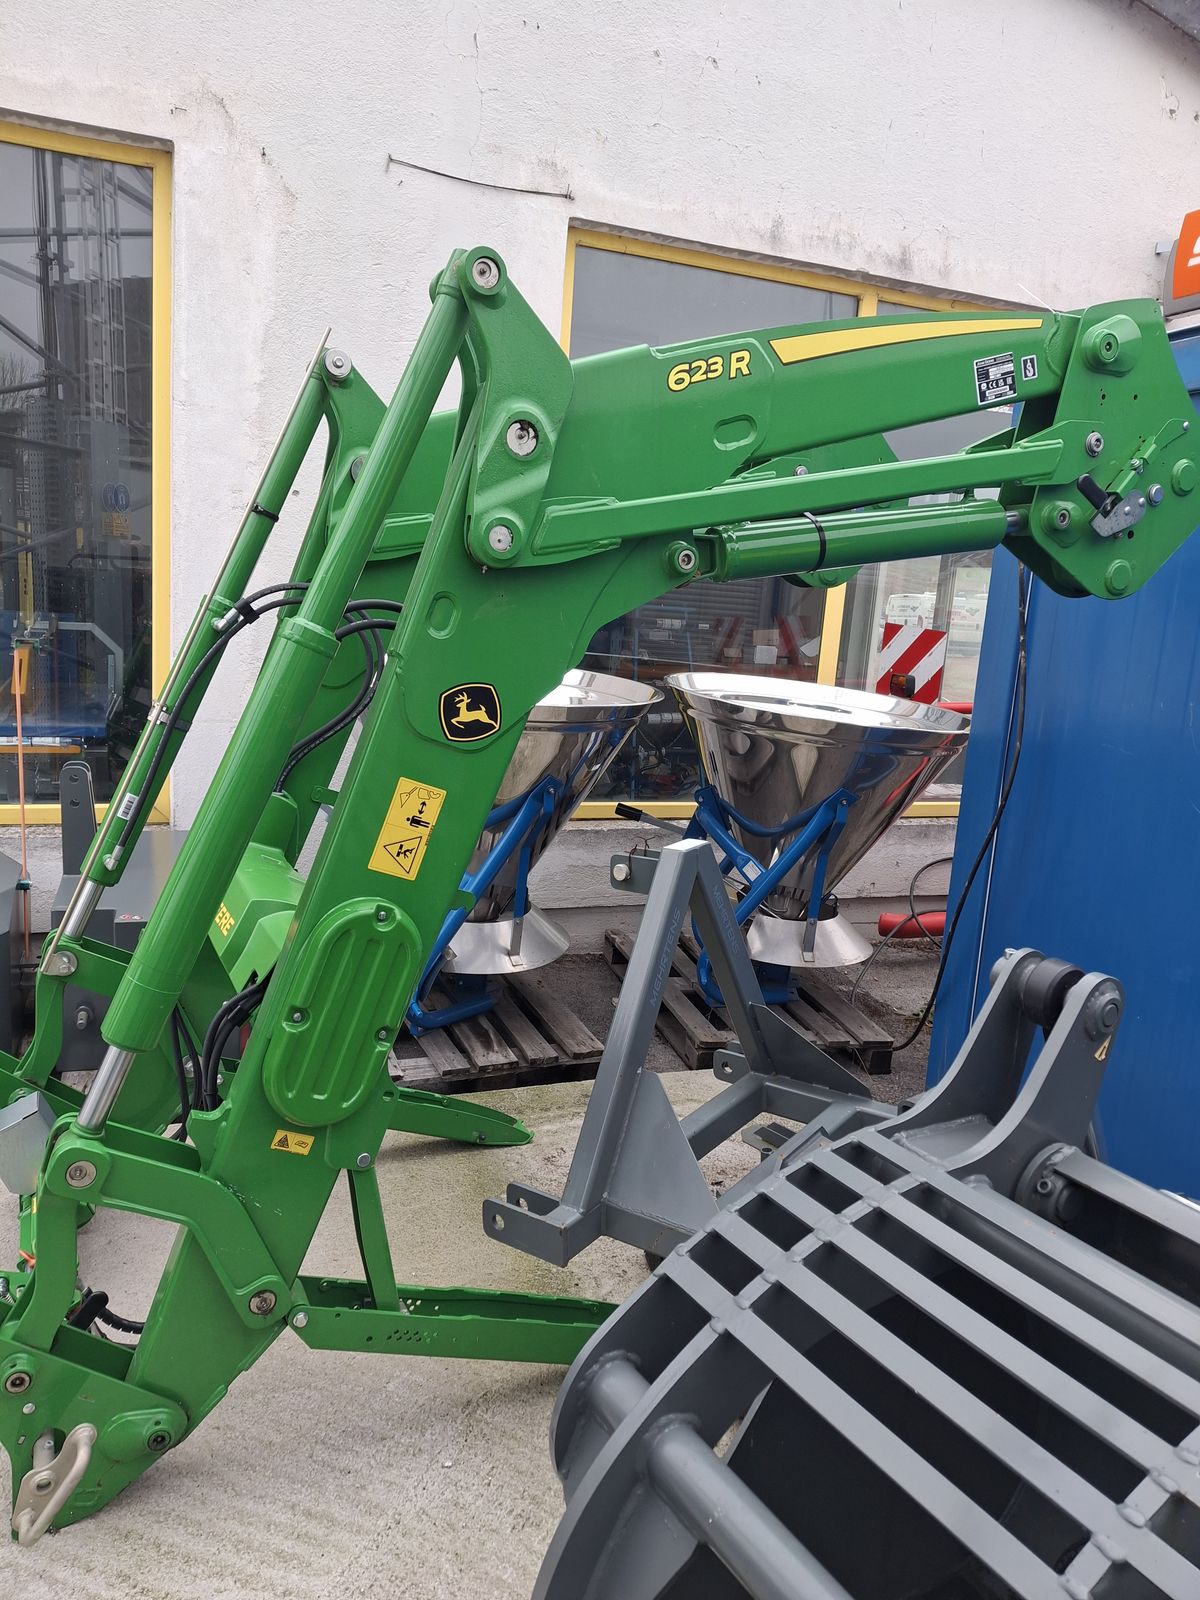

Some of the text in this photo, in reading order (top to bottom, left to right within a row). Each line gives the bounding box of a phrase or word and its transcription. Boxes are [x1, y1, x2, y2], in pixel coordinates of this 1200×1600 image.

[667, 349, 751, 392] 623 R
[214, 901, 236, 937] ERE
[650, 908, 681, 1008] MEHRTENS
